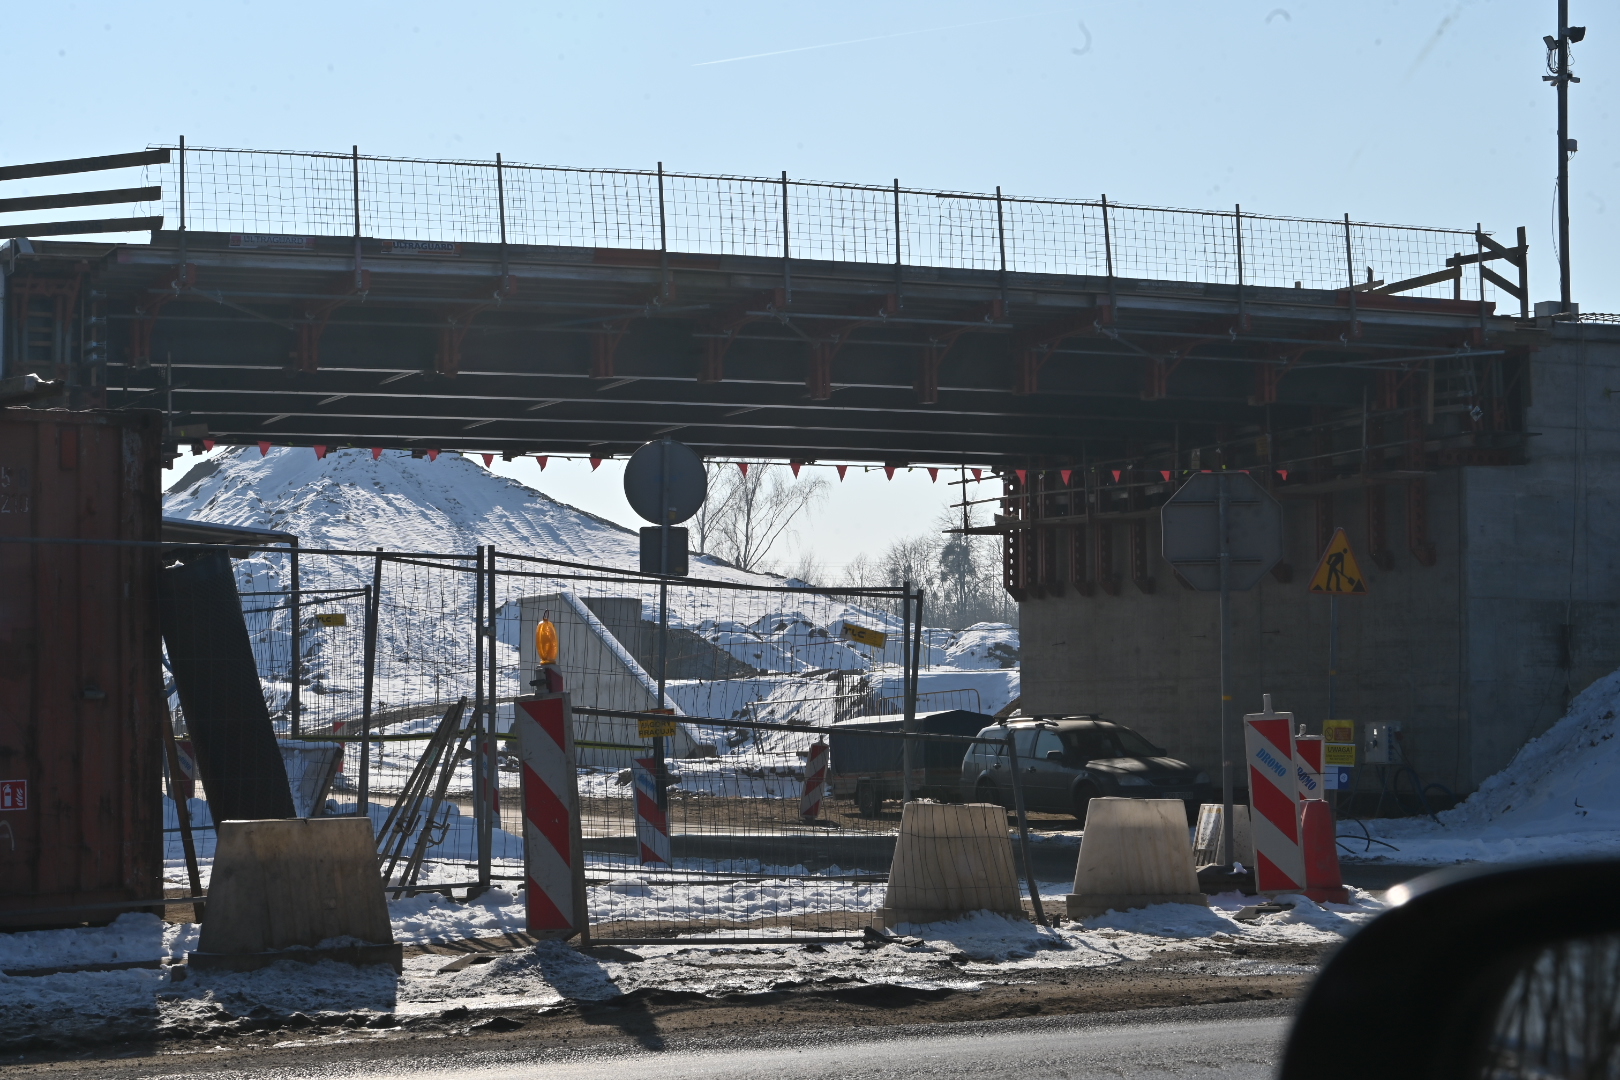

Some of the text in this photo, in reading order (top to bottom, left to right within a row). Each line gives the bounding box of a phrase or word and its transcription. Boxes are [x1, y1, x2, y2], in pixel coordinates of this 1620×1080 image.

[46, 220, 103, 234] SKANSKA
[243, 235, 304, 245] ULTRAGUARD
[393, 241, 454, 251] ULTRAGUARD
[1256, 748, 1287, 777] DROMO
[1297, 765, 1317, 791] ROMO
